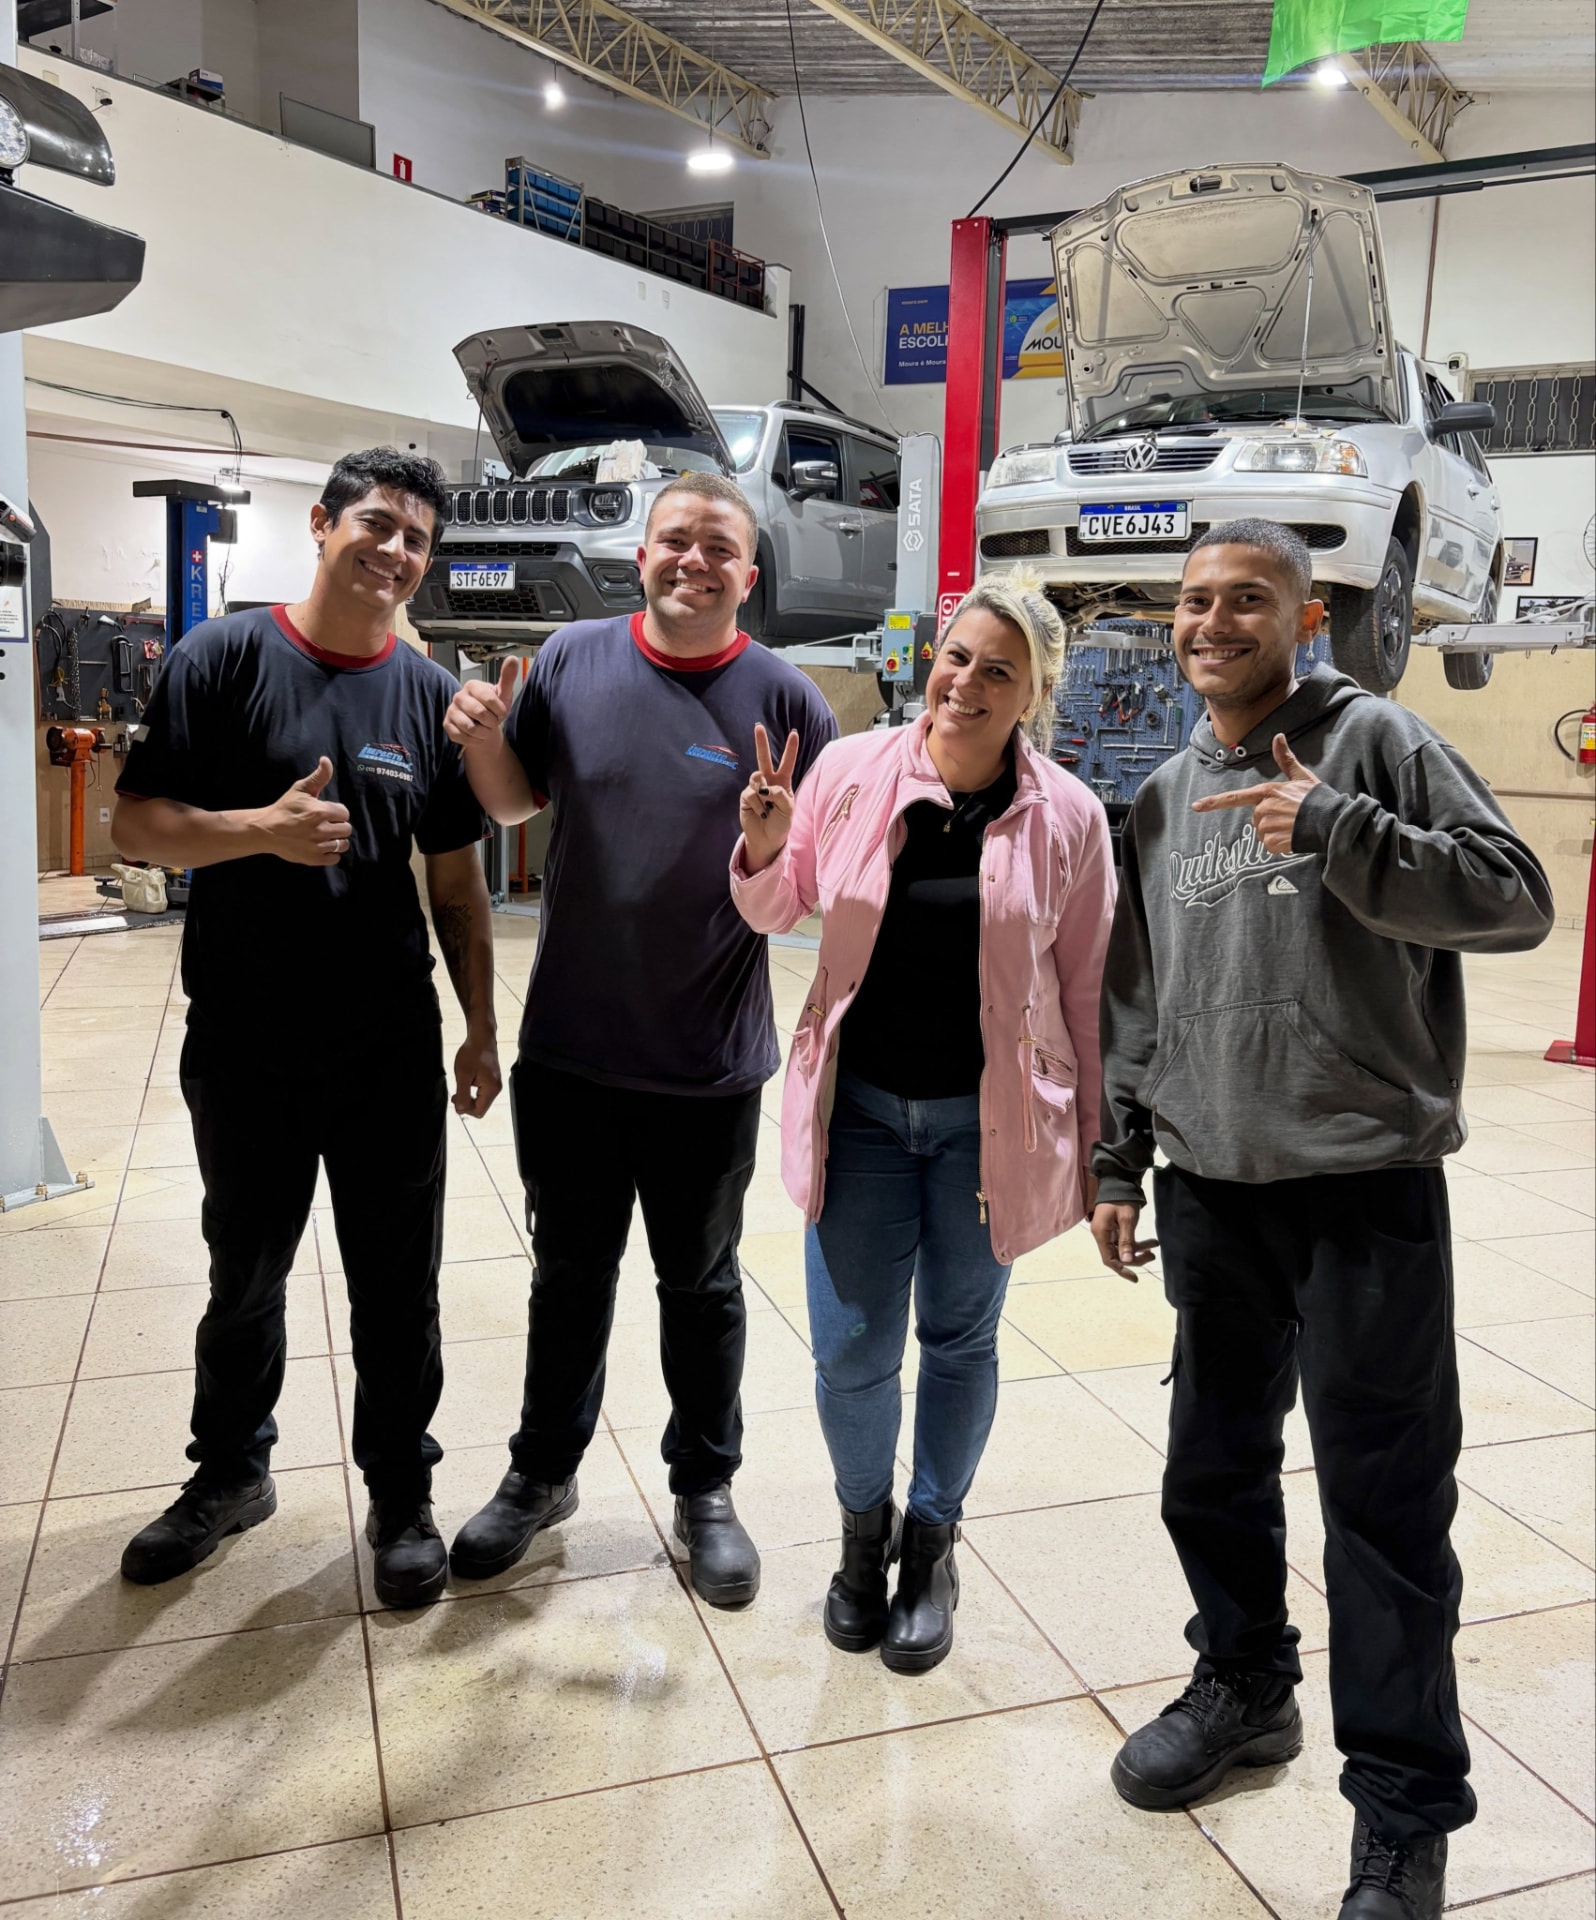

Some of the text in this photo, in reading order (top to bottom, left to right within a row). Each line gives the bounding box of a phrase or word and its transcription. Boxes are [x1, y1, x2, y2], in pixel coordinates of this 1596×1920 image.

[899, 323, 909, 335] A
[1124, 442, 1157, 472] VW
[908, 478, 922, 527] SATA
[1088, 514, 1175, 536] CVE6J43
[456, 572, 507, 587] STF6E97
[1169, 823, 1297, 900] Quiksil
